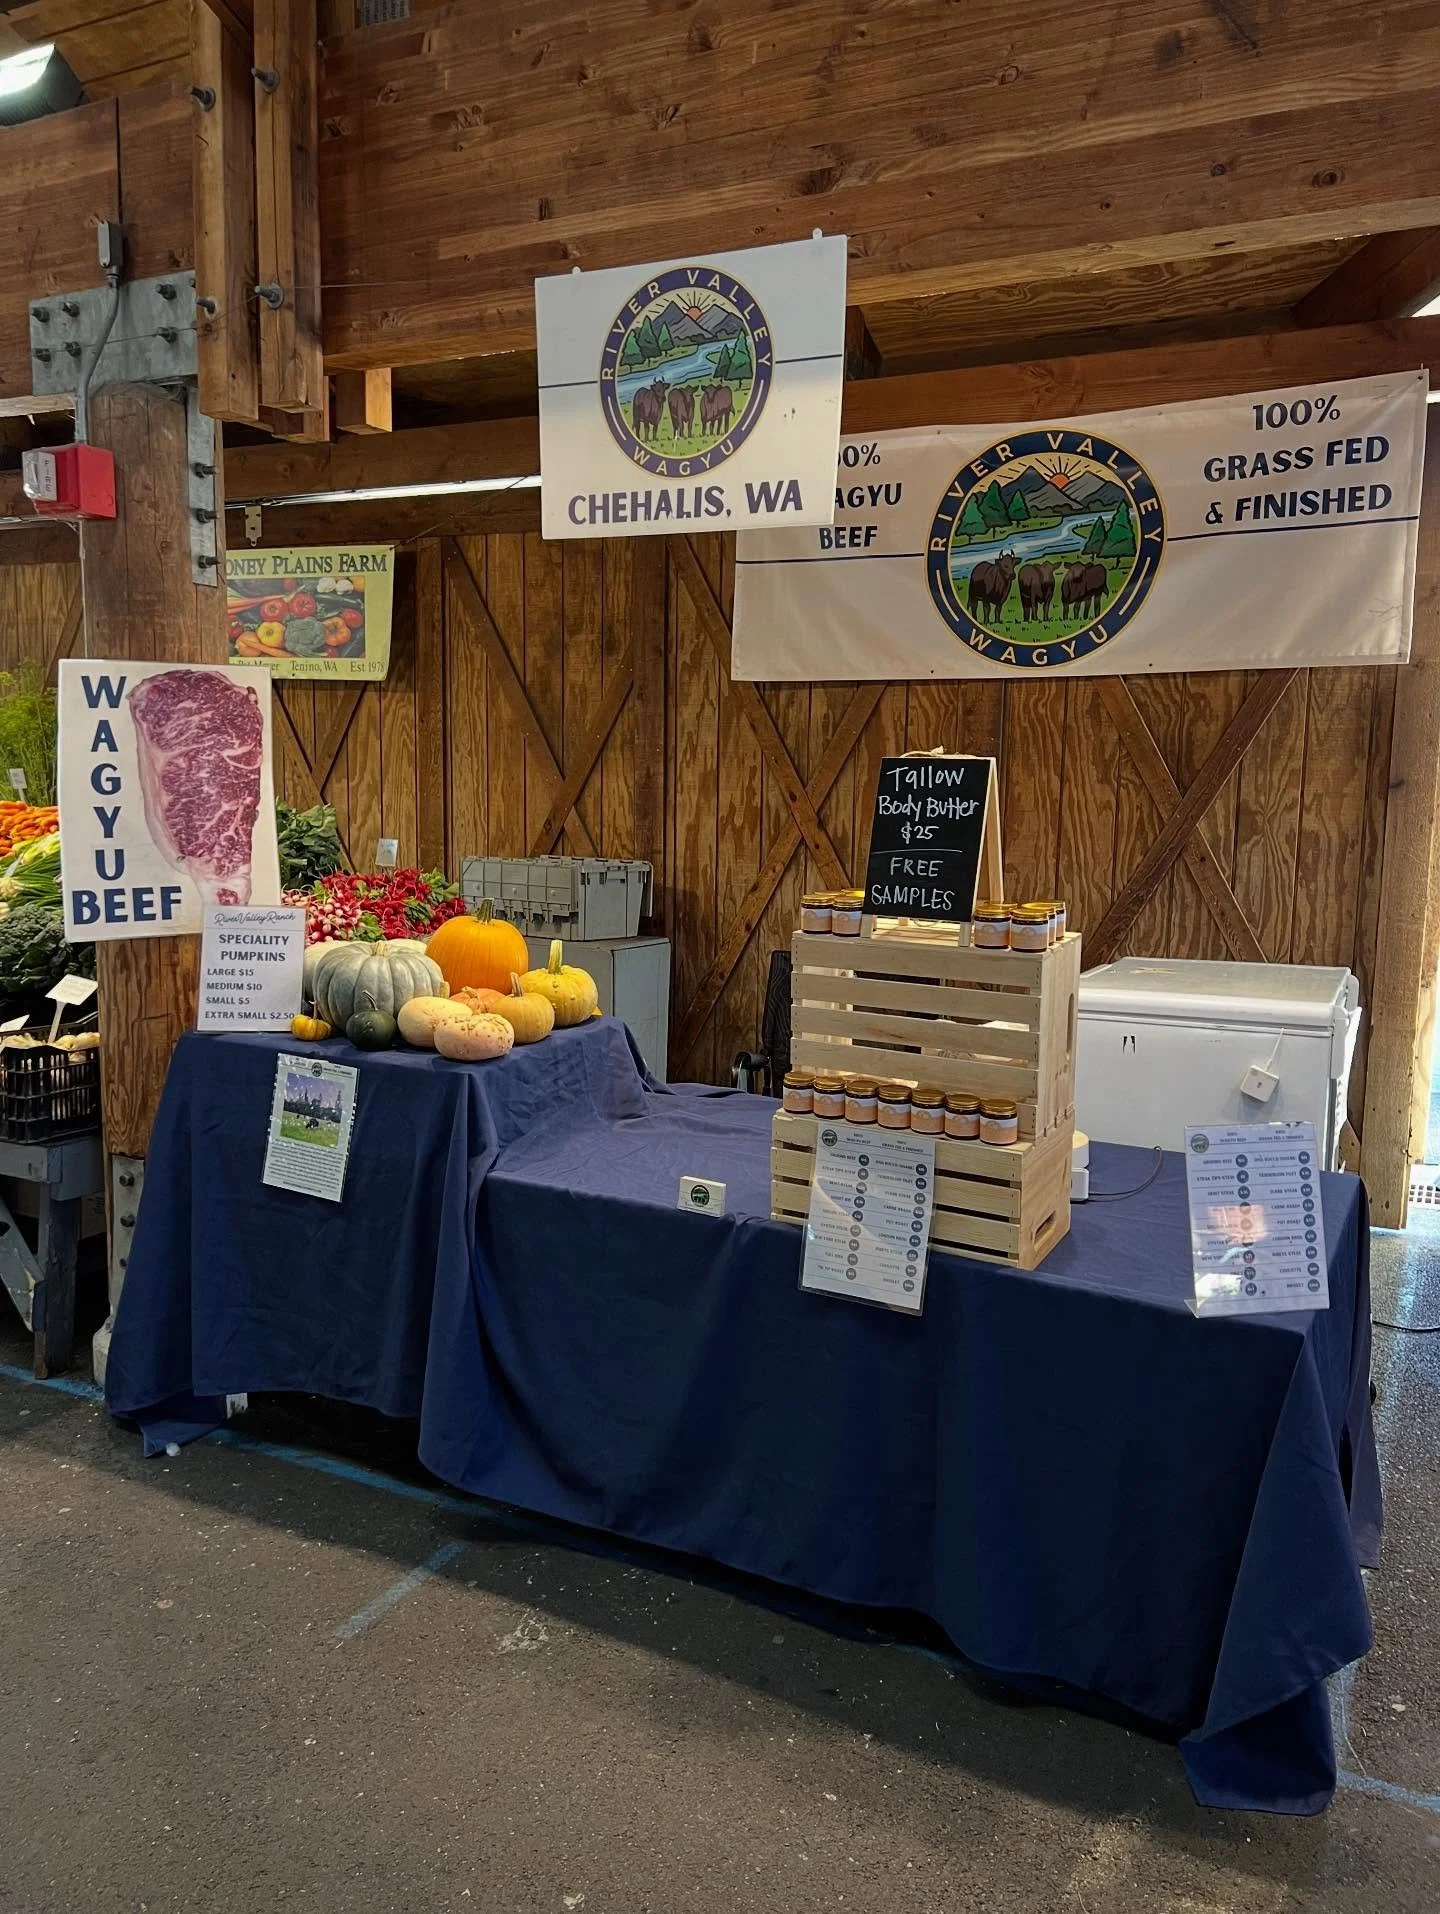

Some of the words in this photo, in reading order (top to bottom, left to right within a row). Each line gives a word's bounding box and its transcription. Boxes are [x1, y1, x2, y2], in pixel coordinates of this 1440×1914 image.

[601, 280, 662, 380] RIVER
[686, 269, 771, 367] VALLEY
[1253, 394, 1341, 431] 100%
[632, 438, 735, 476] WAGYU
[838, 442, 881, 468] 0%
[1203, 446, 1315, 483] GRASS
[1326, 435, 1390, 467] FED
[567, 485, 732, 525] CHEHALIS,
[744, 479, 803, 514] WA
[835, 482, 902, 509] AGYU
[929, 442, 1014, 553] RIVER
[1046, 432, 1163, 543] VALLEY
[1205, 501, 1224, 525] &
[1235, 483, 1393, 522] FINISHED
[819, 525, 878, 550] BEEF
[272, 555, 333, 575] PLAINS
[338, 552, 388, 573] FARM
[968, 623, 1110, 666] WAGYU
[290, 660, 322, 674] Tenino,
[323, 660, 338, 672] WA
[350, 661, 365, 672] Est
[81, 675, 127, 881] WAGYU
[886, 765, 965, 792] Tallow
[878, 794, 922, 822] Body
[926, 796, 980, 820] Butter
[900, 821, 940, 845] $25
[890, 857, 944, 878] FREE
[71, 885, 182, 925] BEEF
[871, 884, 956, 911] SAMPLES
[218, 933, 290, 946] SPECIALITY
[220, 950, 286, 962] PUMPKINS
[207, 968, 236, 976] LARGE
[238, 968, 254, 976] $15
[206, 982, 244, 990] MEDIUM
[246, 982, 262, 991] $10
[205, 996, 236, 1005] SMALL
[238, 997, 250, 1005] $5
[204, 1011, 235, 1019] EXTRA
[237, 1012, 267, 1020] SMALL
